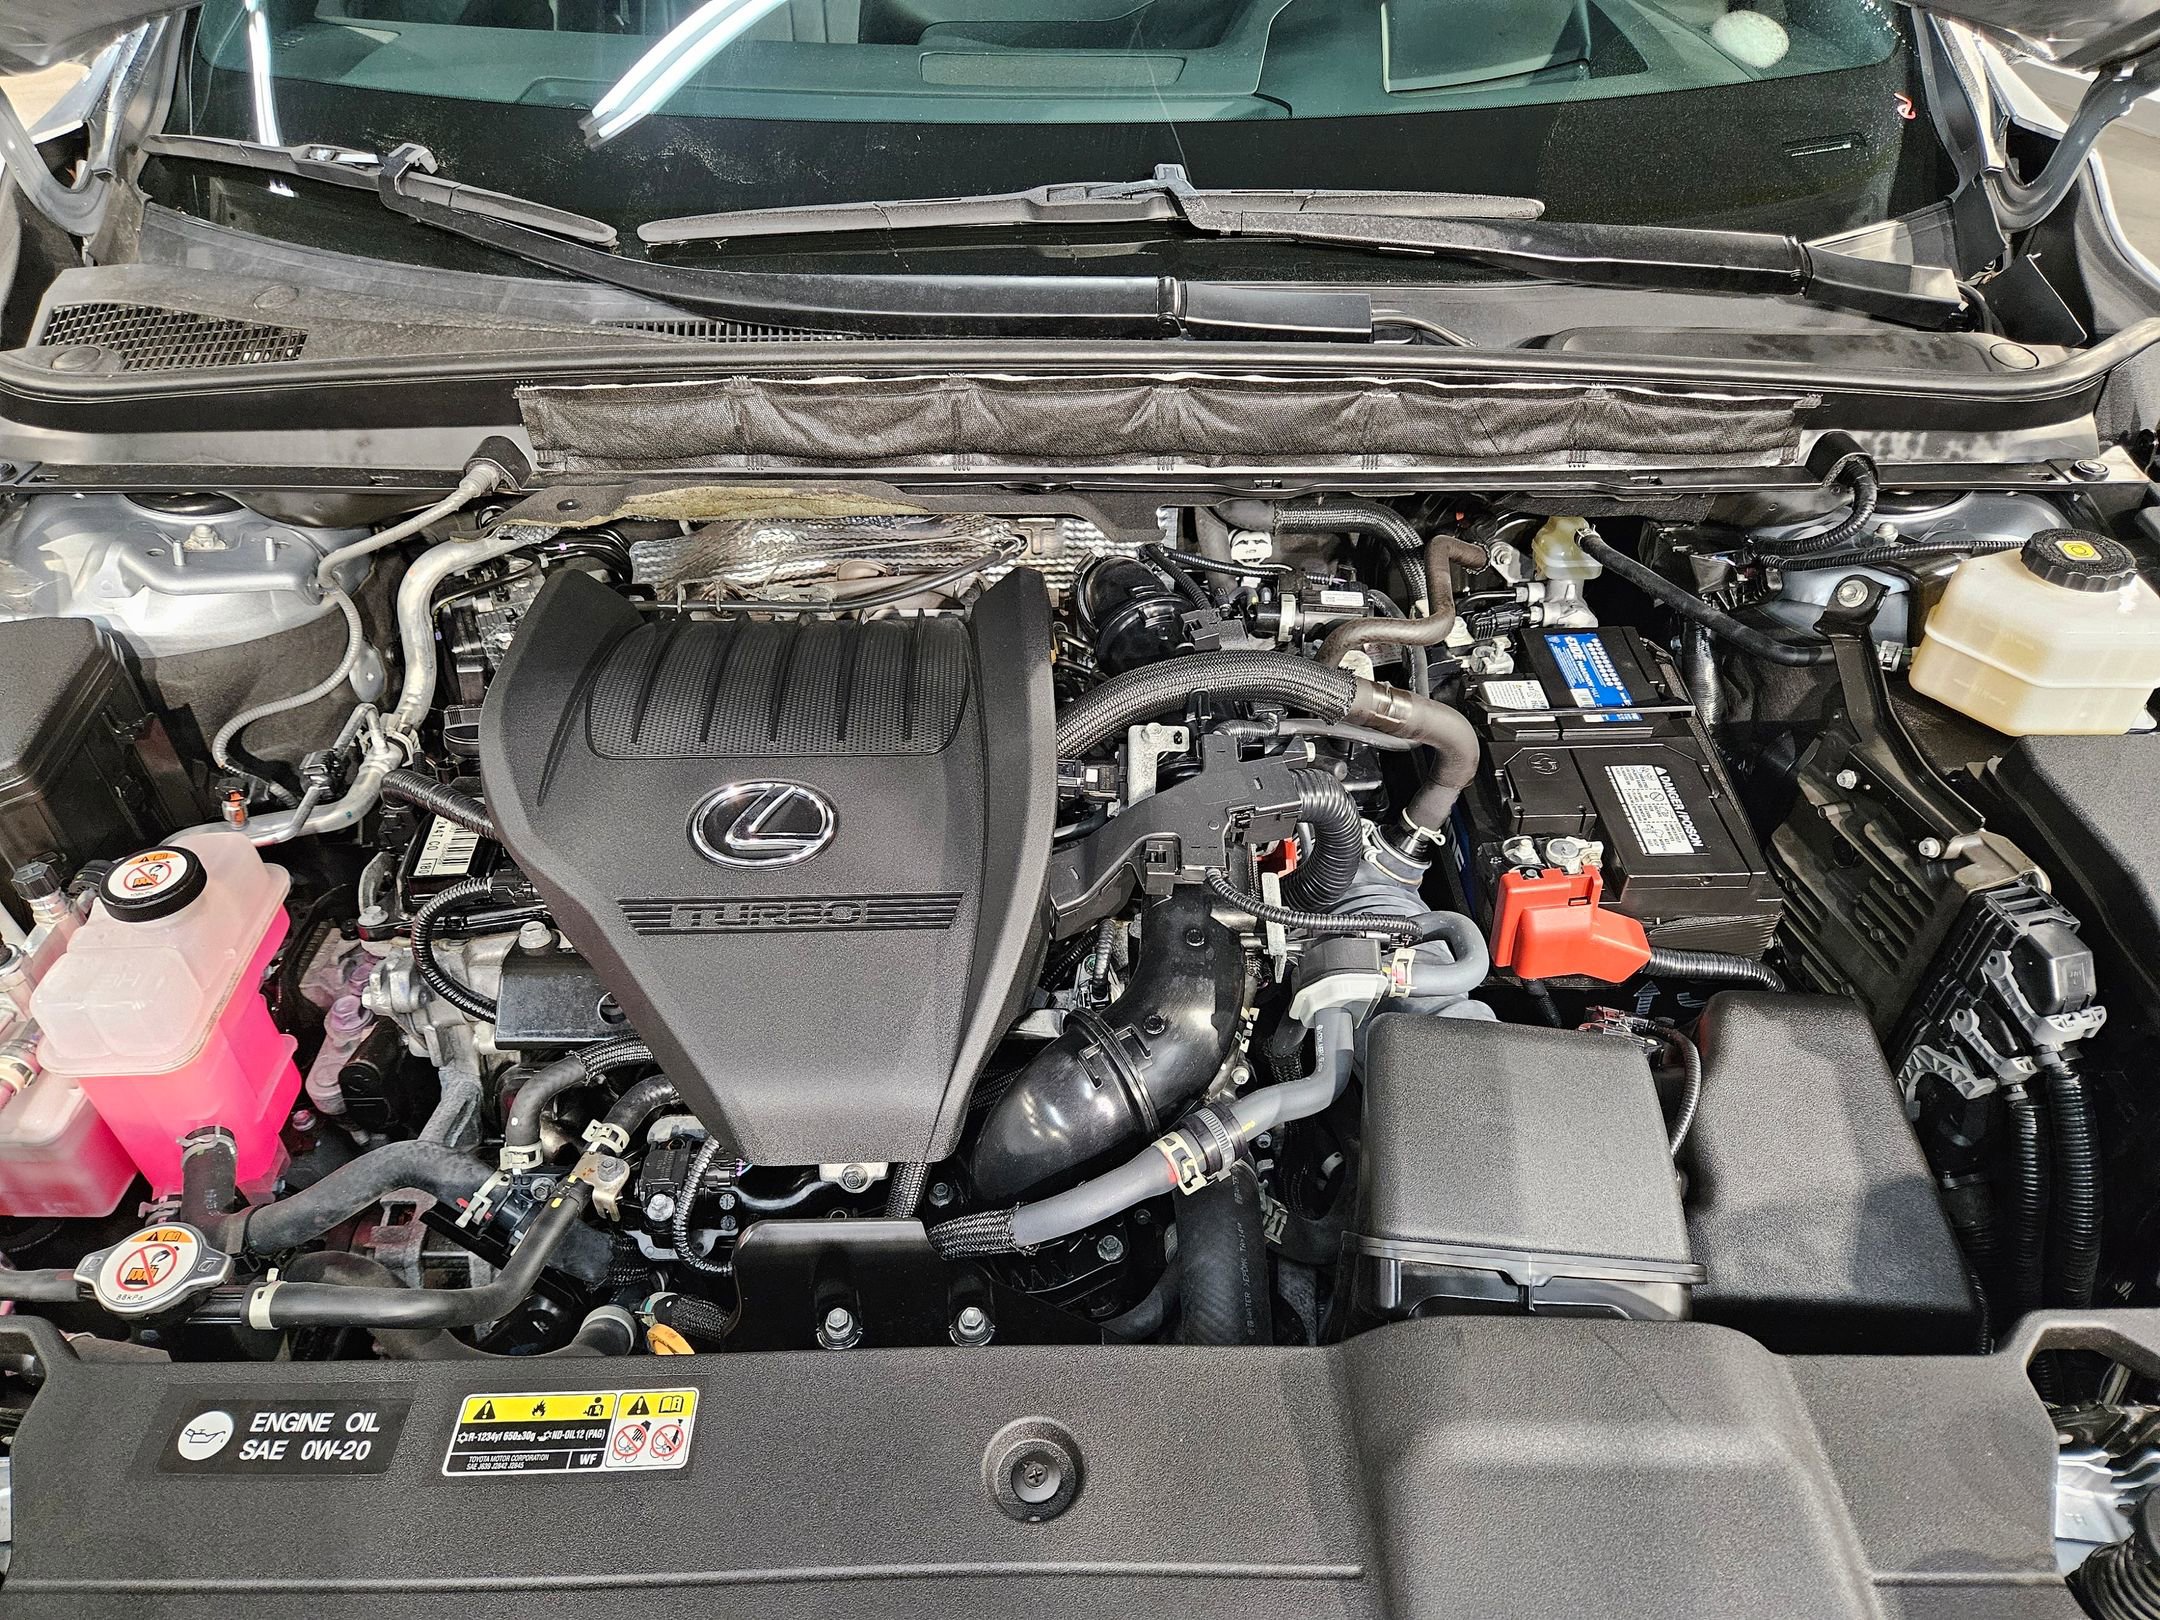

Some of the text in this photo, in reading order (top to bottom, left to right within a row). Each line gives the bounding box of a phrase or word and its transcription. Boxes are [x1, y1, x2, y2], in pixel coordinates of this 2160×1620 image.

[418, 862, 432, 874] 180
[678, 901, 862, 926] TURBO
[249, 1412, 380, 1433] ENGINE OIL
[239, 1440, 371, 1460] SAE 0W-20
[469, 1455, 490, 1463] TOYOTA
[579, 1454, 597, 1465] WF
